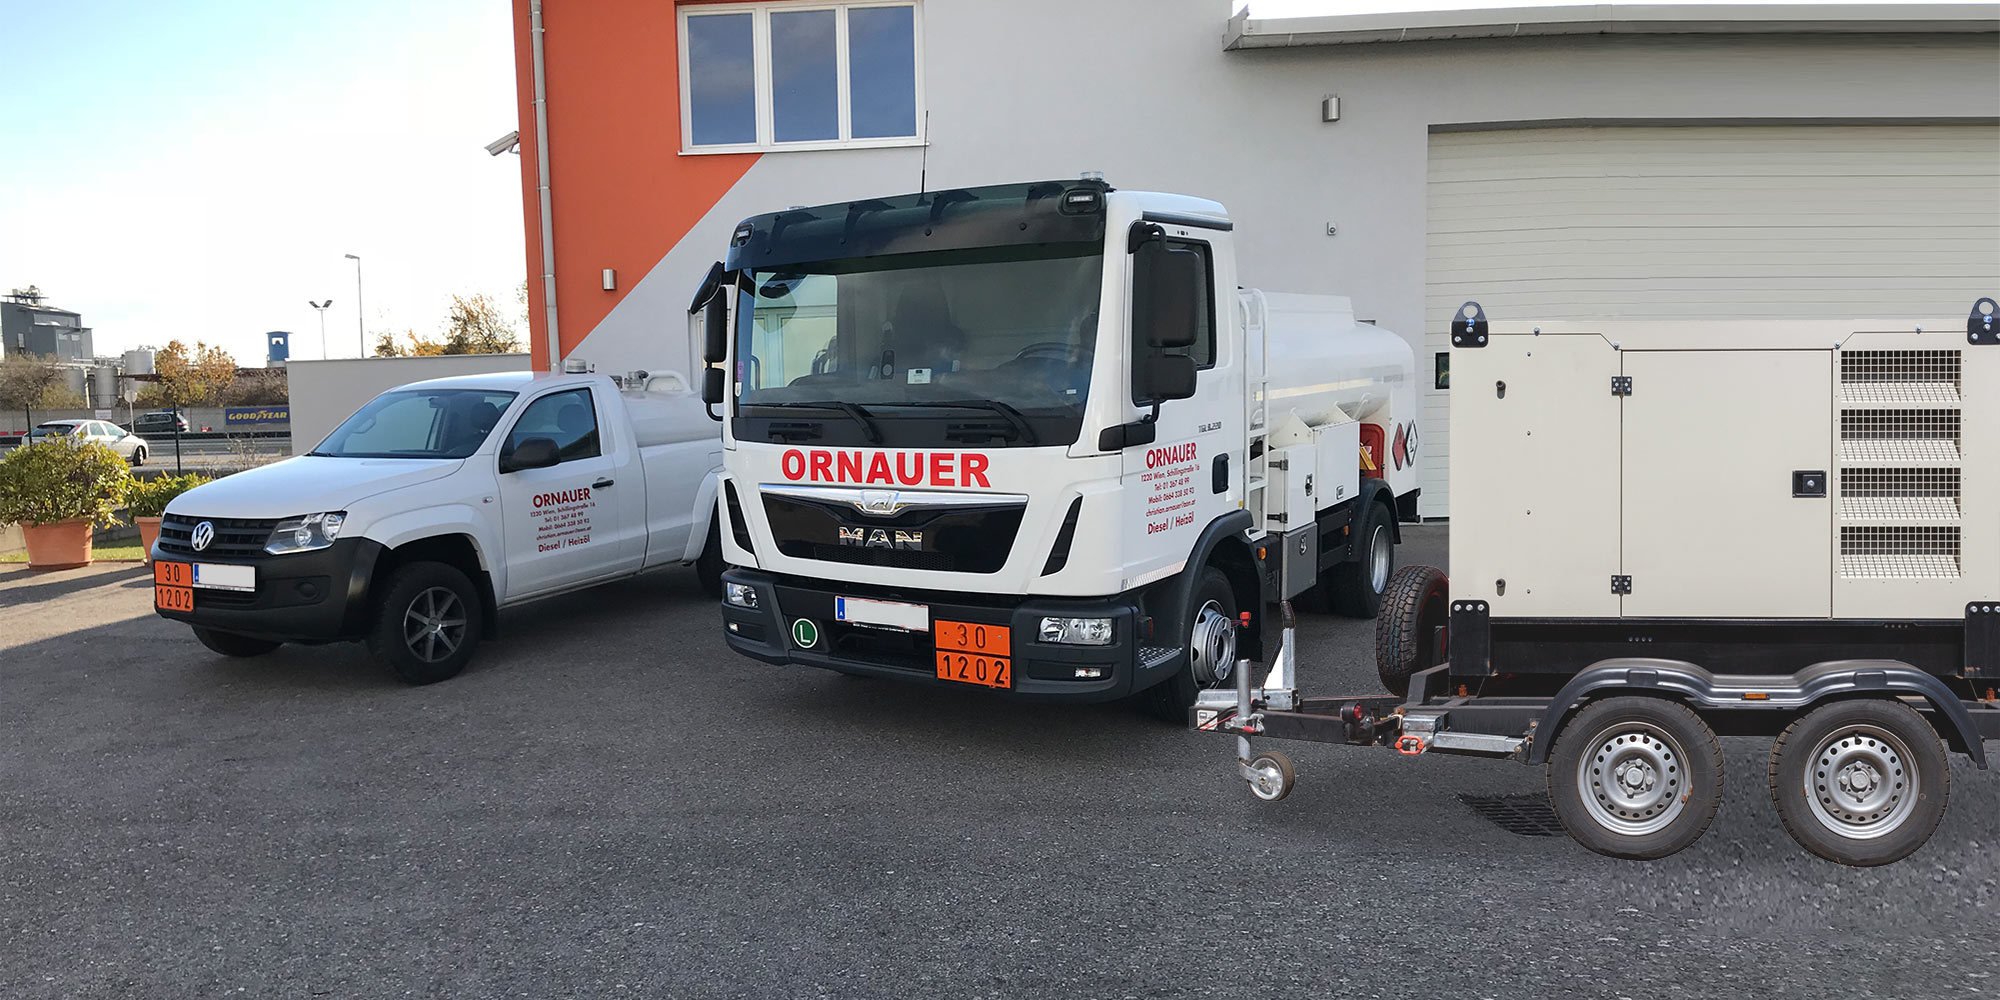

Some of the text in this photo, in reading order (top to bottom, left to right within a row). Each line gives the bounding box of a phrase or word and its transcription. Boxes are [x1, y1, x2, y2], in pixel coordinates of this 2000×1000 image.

[228, 410, 287, 420] GOODYEAR
[1146, 442, 1197, 469] ORNAUER
[781, 448, 992, 488] ORNAUER
[1141, 473, 1152, 482] 1220
[1166, 464, 1194, 477] Schillingstraße
[532, 488, 591, 508] ORNAUER
[1163, 492, 1174, 501] 0664
[558, 503, 588, 512] Schillingstraße
[1148, 511, 1194, 534] Diesel / Heizöl
[538, 540, 560, 552] Diesel
[568, 534, 590, 546] Heizöl
[838, 526, 923, 551] MAN
[164, 564, 180, 582] 30
[159, 588, 191, 610] 1202
[800, 624, 811, 644] L
[957, 624, 986, 649] 30
[943, 655, 1005, 685] 1202
